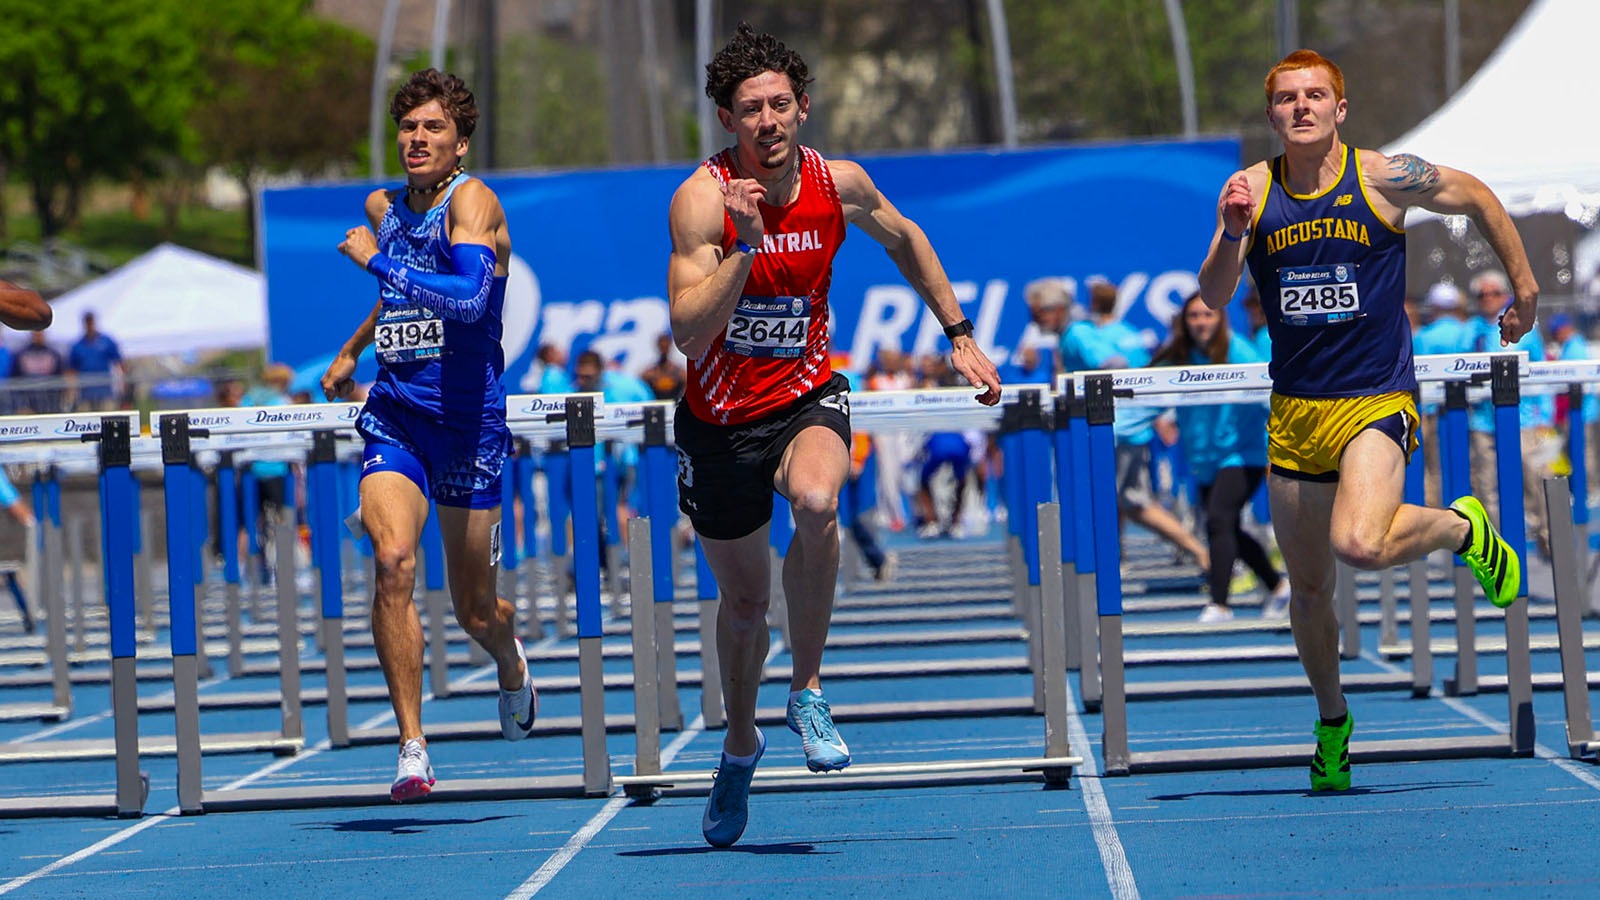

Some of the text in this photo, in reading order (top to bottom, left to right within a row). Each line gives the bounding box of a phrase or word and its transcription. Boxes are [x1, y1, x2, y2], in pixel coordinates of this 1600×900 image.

[758, 229, 823, 254] NTRAL
[1266, 218, 1371, 256] AUGUSTANA
[1287, 271, 1311, 281] Drake
[1283, 286, 1355, 312] 2485
[379, 321, 441, 349] 3194
[730, 317, 805, 343] 2644
[1454, 358, 1490, 371] Drake
[1178, 369, 1214, 383] Drake
[530, 398, 567, 412] Drake
[255, 410, 292, 423] Drake
[64, 419, 101, 433] Drake
